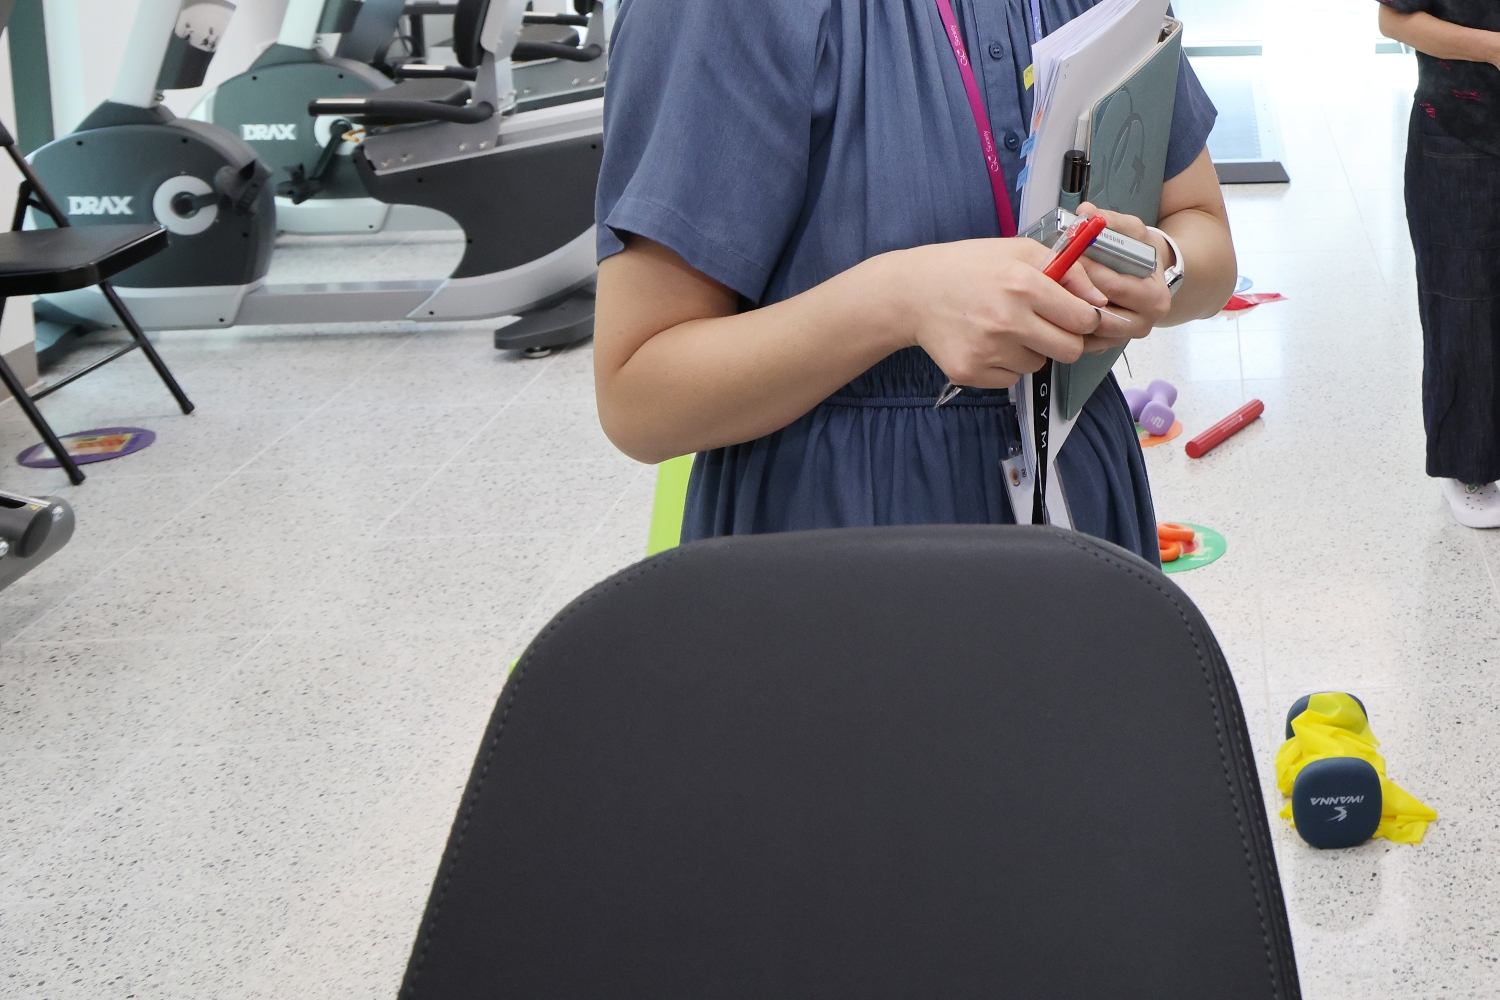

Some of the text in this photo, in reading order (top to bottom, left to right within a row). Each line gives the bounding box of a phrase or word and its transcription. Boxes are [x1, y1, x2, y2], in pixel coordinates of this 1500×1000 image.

[950, 24, 961, 47] Society
[243, 124, 298, 141] DRAX
[983, 130, 993, 153] Society
[67, 195, 134, 216] DRAX
[1100, 231, 1125, 246] AMSUNG
[1039, 382, 1048, 449] GYM
